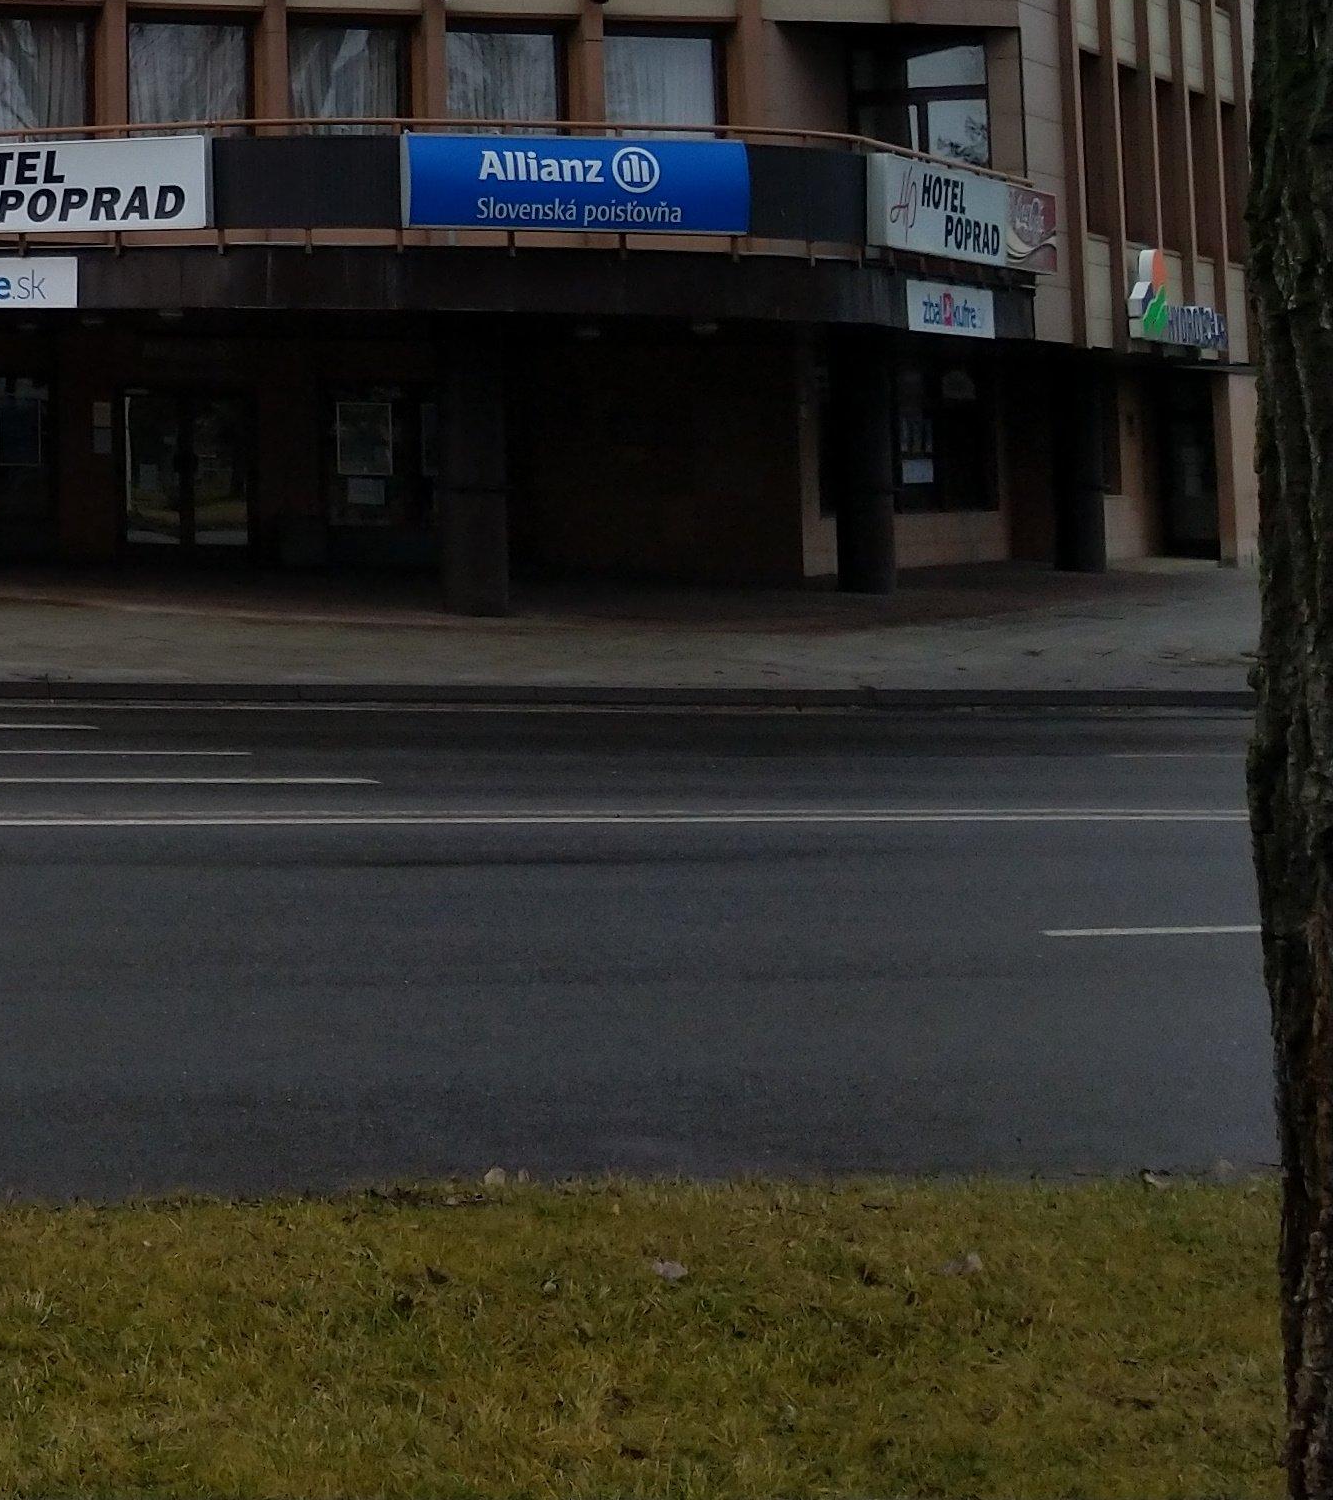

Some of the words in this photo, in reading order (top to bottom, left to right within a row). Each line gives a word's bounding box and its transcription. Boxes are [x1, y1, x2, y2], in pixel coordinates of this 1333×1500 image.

[478, 150, 605, 183] Allianz
[476, 197, 576, 221] Slovenská
[583, 200, 683, 226] poisťovňa
[921, 173, 967, 215] HOTEL
[944, 215, 1000, 257] POPRAD
